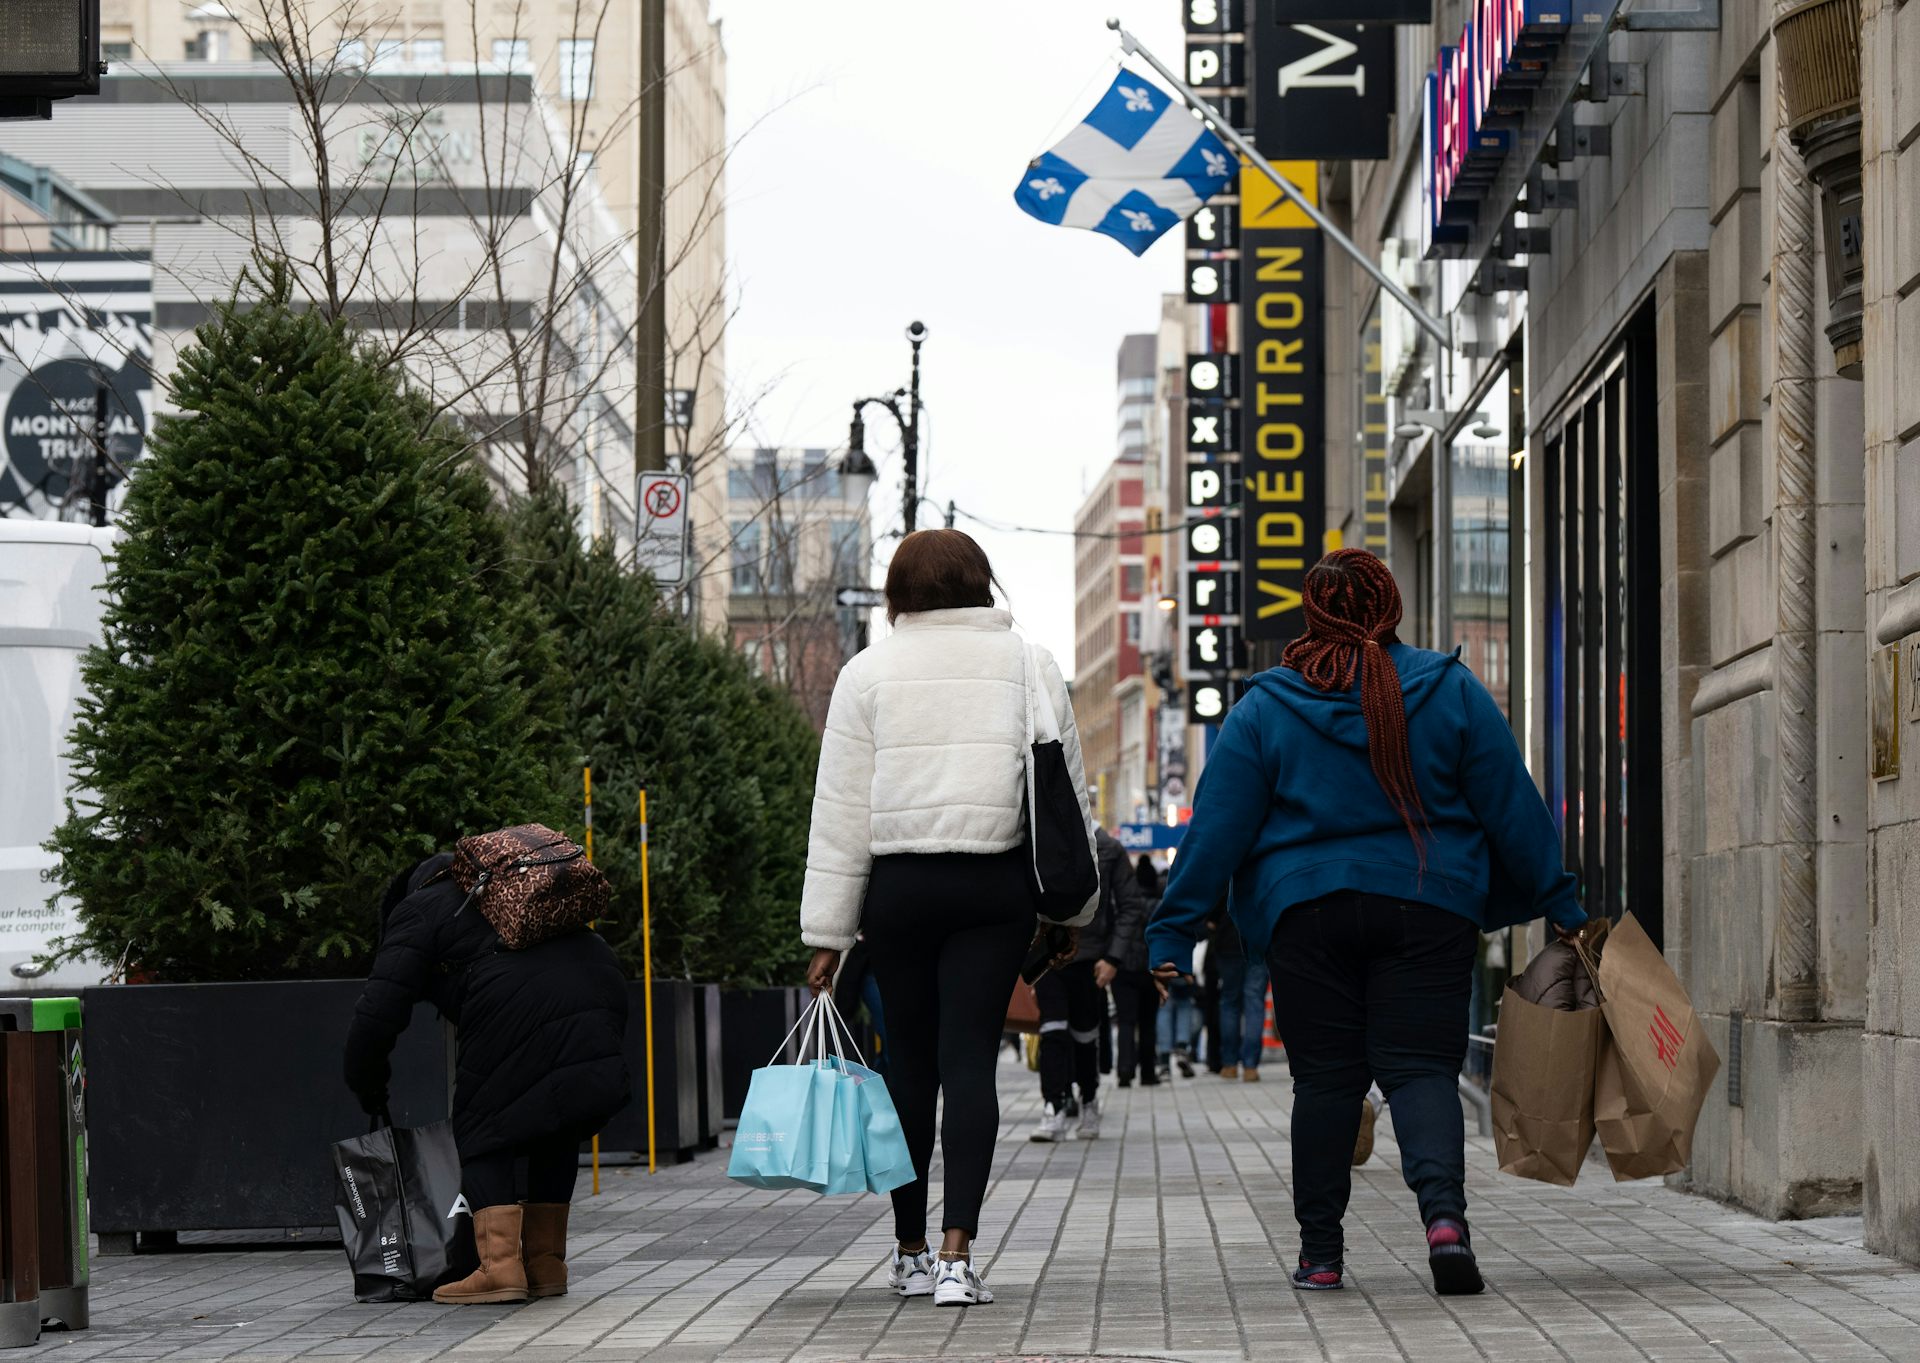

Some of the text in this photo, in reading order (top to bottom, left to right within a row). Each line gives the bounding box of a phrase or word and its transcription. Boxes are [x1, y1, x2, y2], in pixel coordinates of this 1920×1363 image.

[1245, 246, 1304, 619] VIDÉOTRON
[1190, 361, 1223, 717] experts
[0, 907, 65, 919] ur lesquels
[16, 922, 66, 933] compter
[344, 1166, 366, 1219] aldoshoes.com
